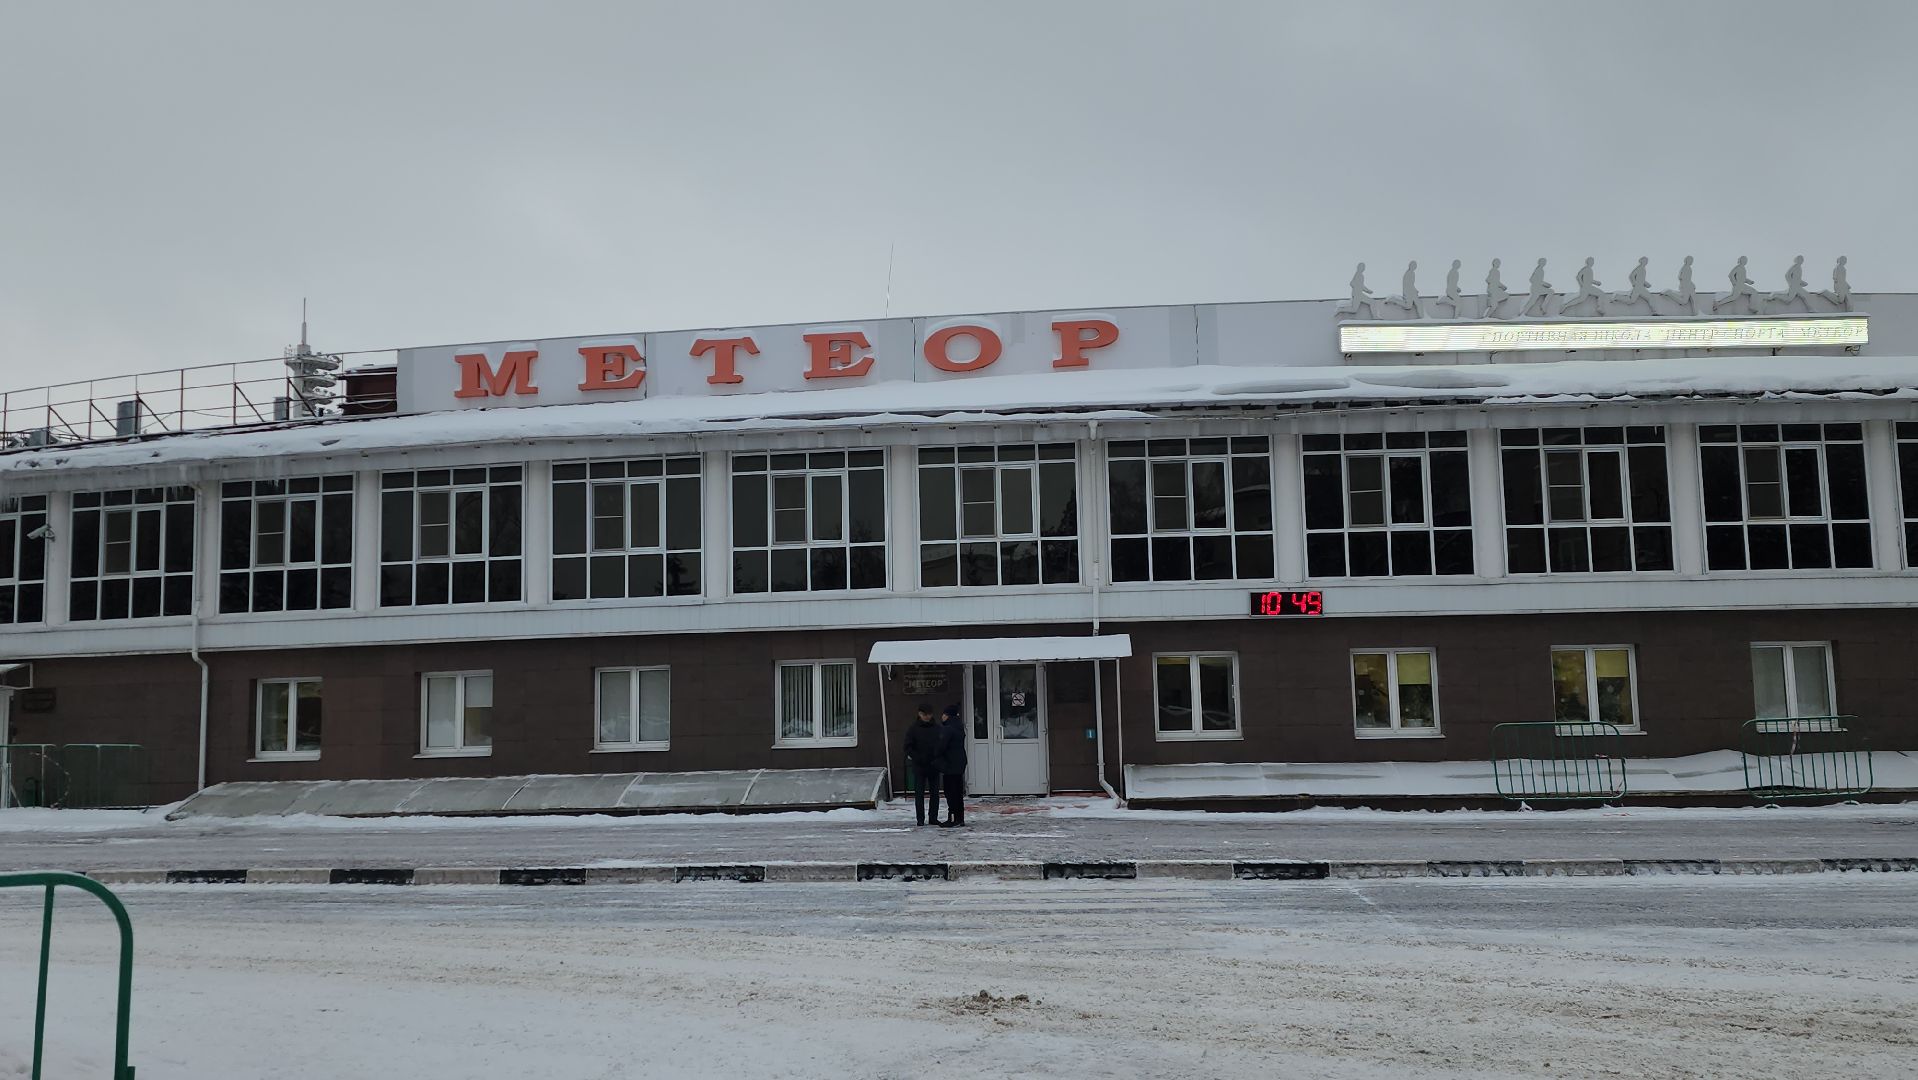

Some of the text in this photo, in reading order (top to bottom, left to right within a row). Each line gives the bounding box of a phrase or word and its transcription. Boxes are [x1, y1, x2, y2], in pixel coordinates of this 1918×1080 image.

[454, 319, 1120, 399] МЕТЕОР
[1261, 591, 1322, 615] 10 49
